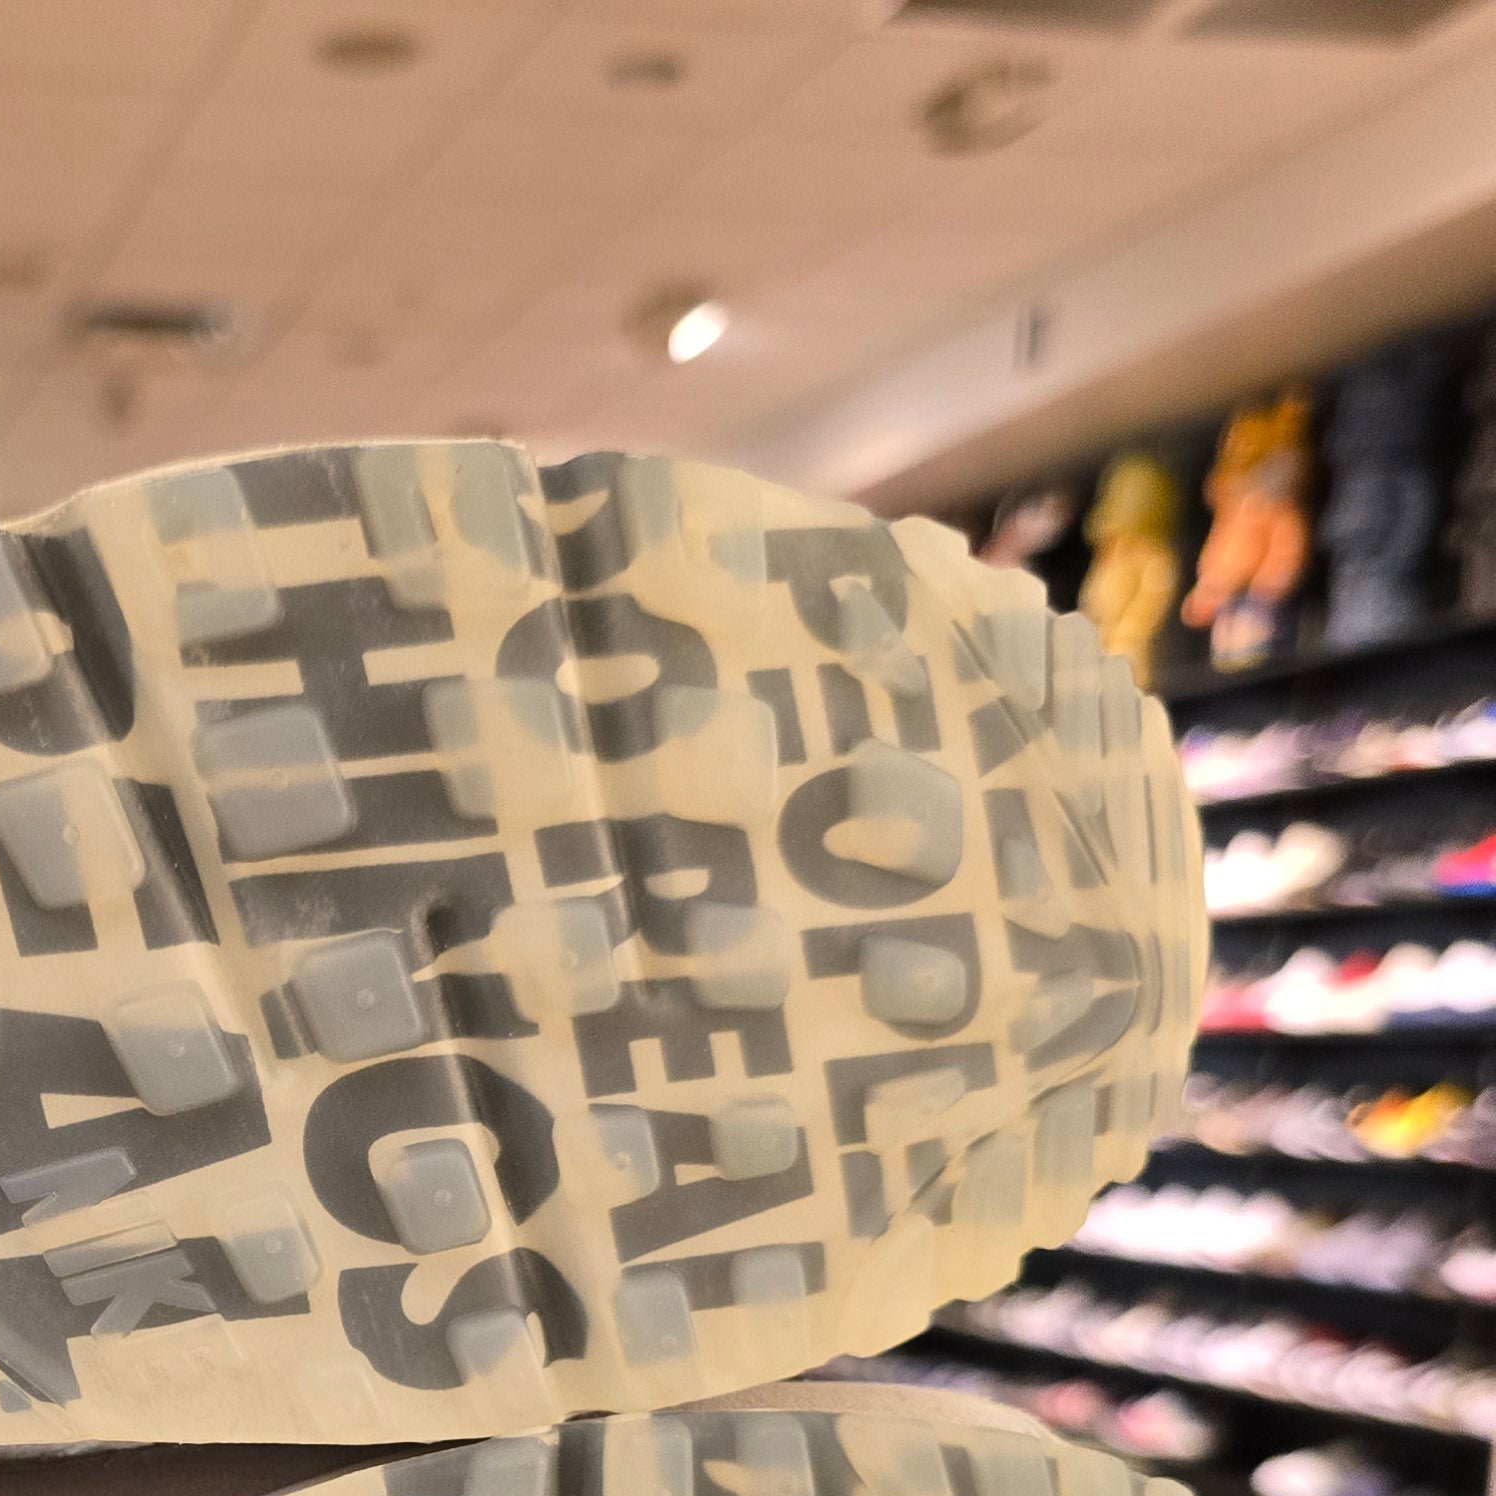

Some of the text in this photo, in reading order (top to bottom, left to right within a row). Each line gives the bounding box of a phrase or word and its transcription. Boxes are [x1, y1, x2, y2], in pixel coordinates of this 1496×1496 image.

[148, 442, 590, 1392] THINGS
[450, 450, 826, 1367] DO REAL
